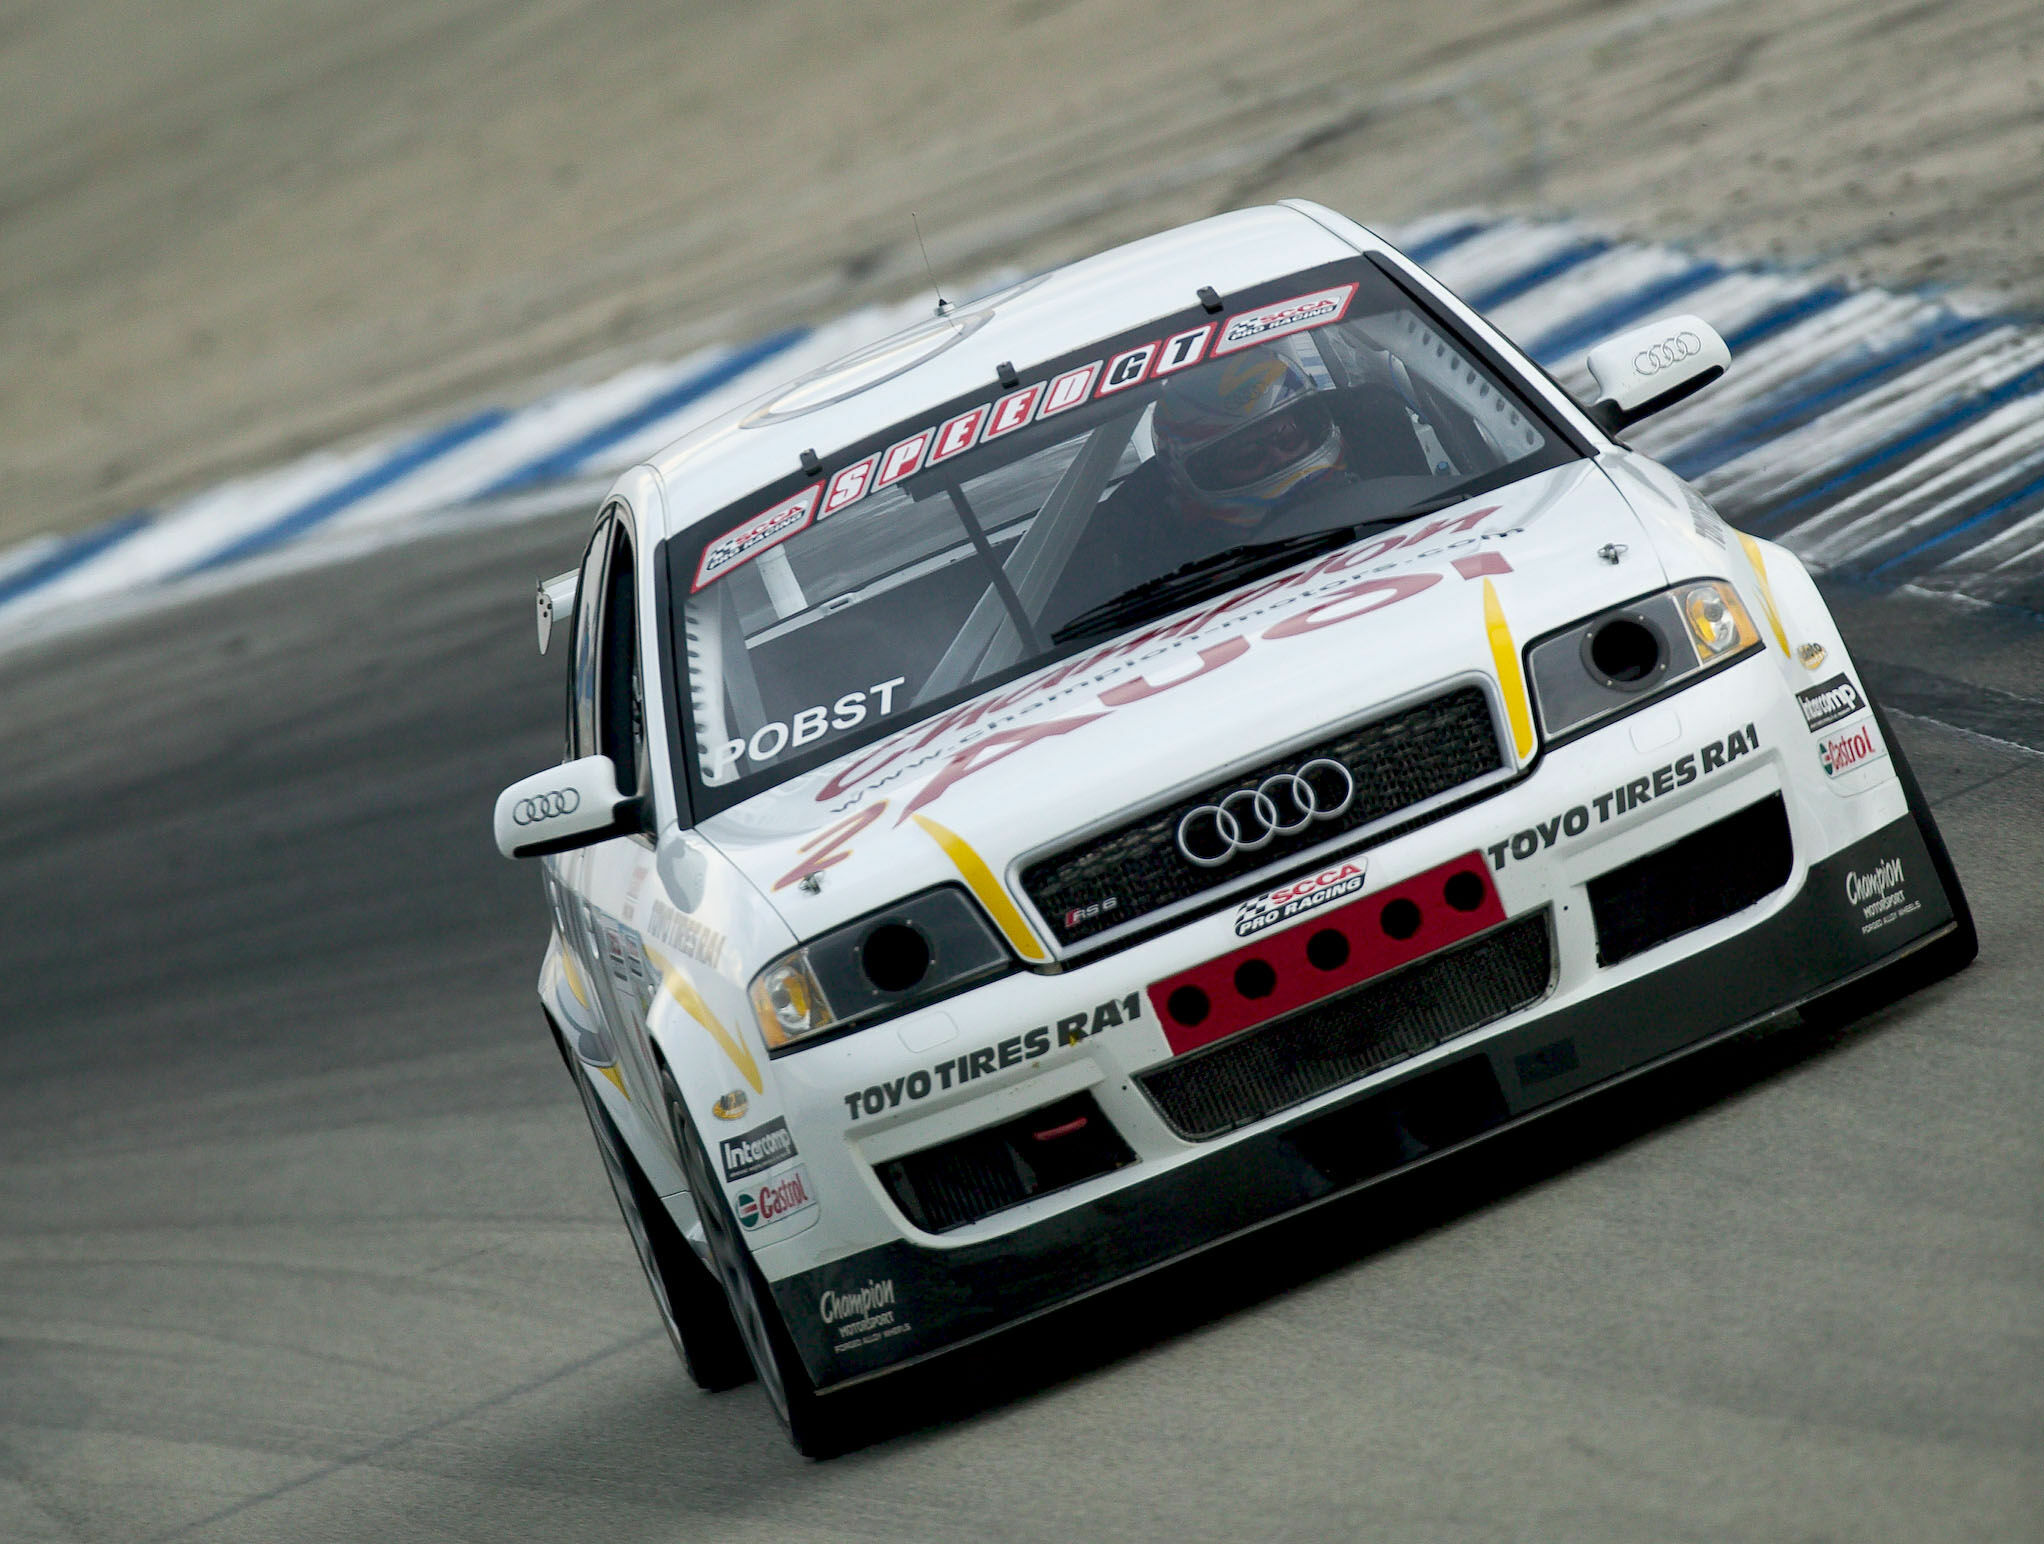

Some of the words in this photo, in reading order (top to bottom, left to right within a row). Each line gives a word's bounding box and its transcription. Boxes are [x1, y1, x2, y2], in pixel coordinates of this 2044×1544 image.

[1259, 299, 1335, 325] SCCA
[826, 366, 1094, 510] SPEED
[1106, 328, 1208, 390] GT
[735, 505, 804, 546] SCCA
[1797, 683, 1857, 721] Intercomp
[713, 676, 905, 781] POBST
[1828, 724, 1876, 771] Castrol
[1488, 805, 1589, 871] TOYO
[1593, 754, 1697, 824] TIRES
[1701, 722, 1760, 775] RA1
[770, 799, 889, 893] 2
[1239, 909, 1280, 936] PRO
[1283, 874, 1362, 916] RACING
[1270, 863, 1362, 905] SCCA
[1846, 857, 1904, 906] Champion
[844, 1070, 932, 1120] TOYO
[934, 1026, 1051, 1090] TIRES
[1057, 991, 1142, 1048] RA1
[724, 1128, 792, 1170] Intercomp
[760, 1172, 808, 1219] Castrol
[820, 1278, 896, 1324] Champion
